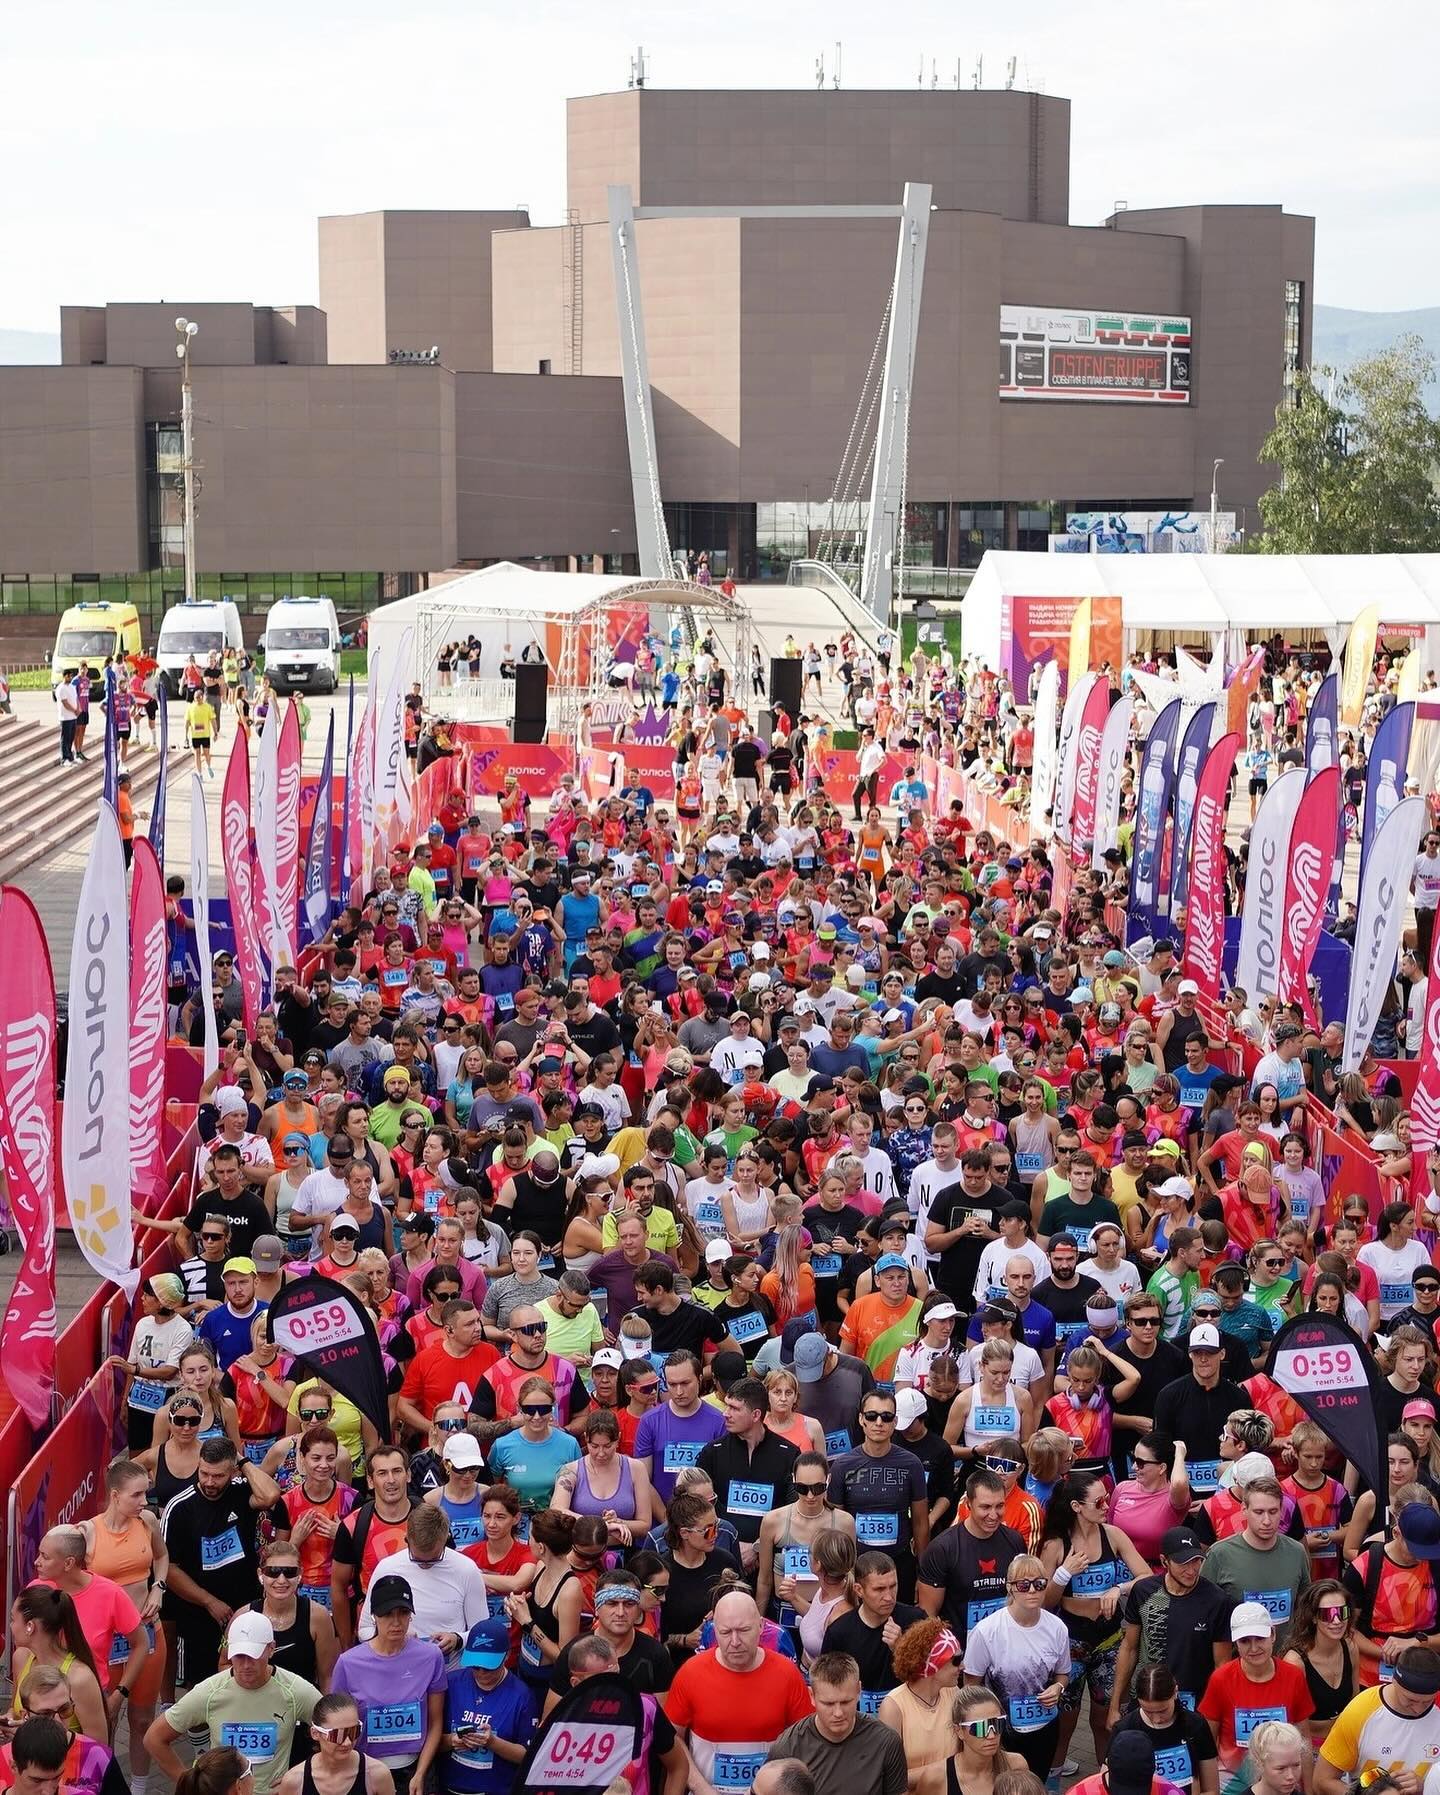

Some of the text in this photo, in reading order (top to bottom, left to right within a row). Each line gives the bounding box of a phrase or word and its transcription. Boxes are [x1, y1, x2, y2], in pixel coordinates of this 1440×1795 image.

[848, 774, 885, 782] ПОС
[1018, 1158, 1040, 1166] 1566
[1383, 1289, 1410, 1300] 1364
[289, 1305, 346, 1339] 0:59
[734, 1318, 762, 1336] 1704
[334, 1327, 352, 1338] 5:54
[320, 1349, 337, 1364] 10
[1293, 1350, 1352, 1377] 0:59
[1336, 1375, 1354, 1384] 5:54
[134, 1388, 160, 1405] 1672
[1316, 1395, 1336, 1408] 10
[979, 1414, 1010, 1426] 1512
[733, 1490, 768, 1505] 1609
[453, 1527, 480, 1540] 274
[860, 1522, 894, 1535] 1385
[206, 1538, 236, 1559] 1162
[790, 1555, 808, 1567] 16
[1077, 1572, 1112, 1588] 1492
[373, 1713, 416, 1729] 1304
[228, 1734, 270, 1749] 1538
[551, 1731, 615, 1764] 0:49
[543, 1768, 585, 1778] темп 4:54
[1156, 1757, 1187, 1776] 532
